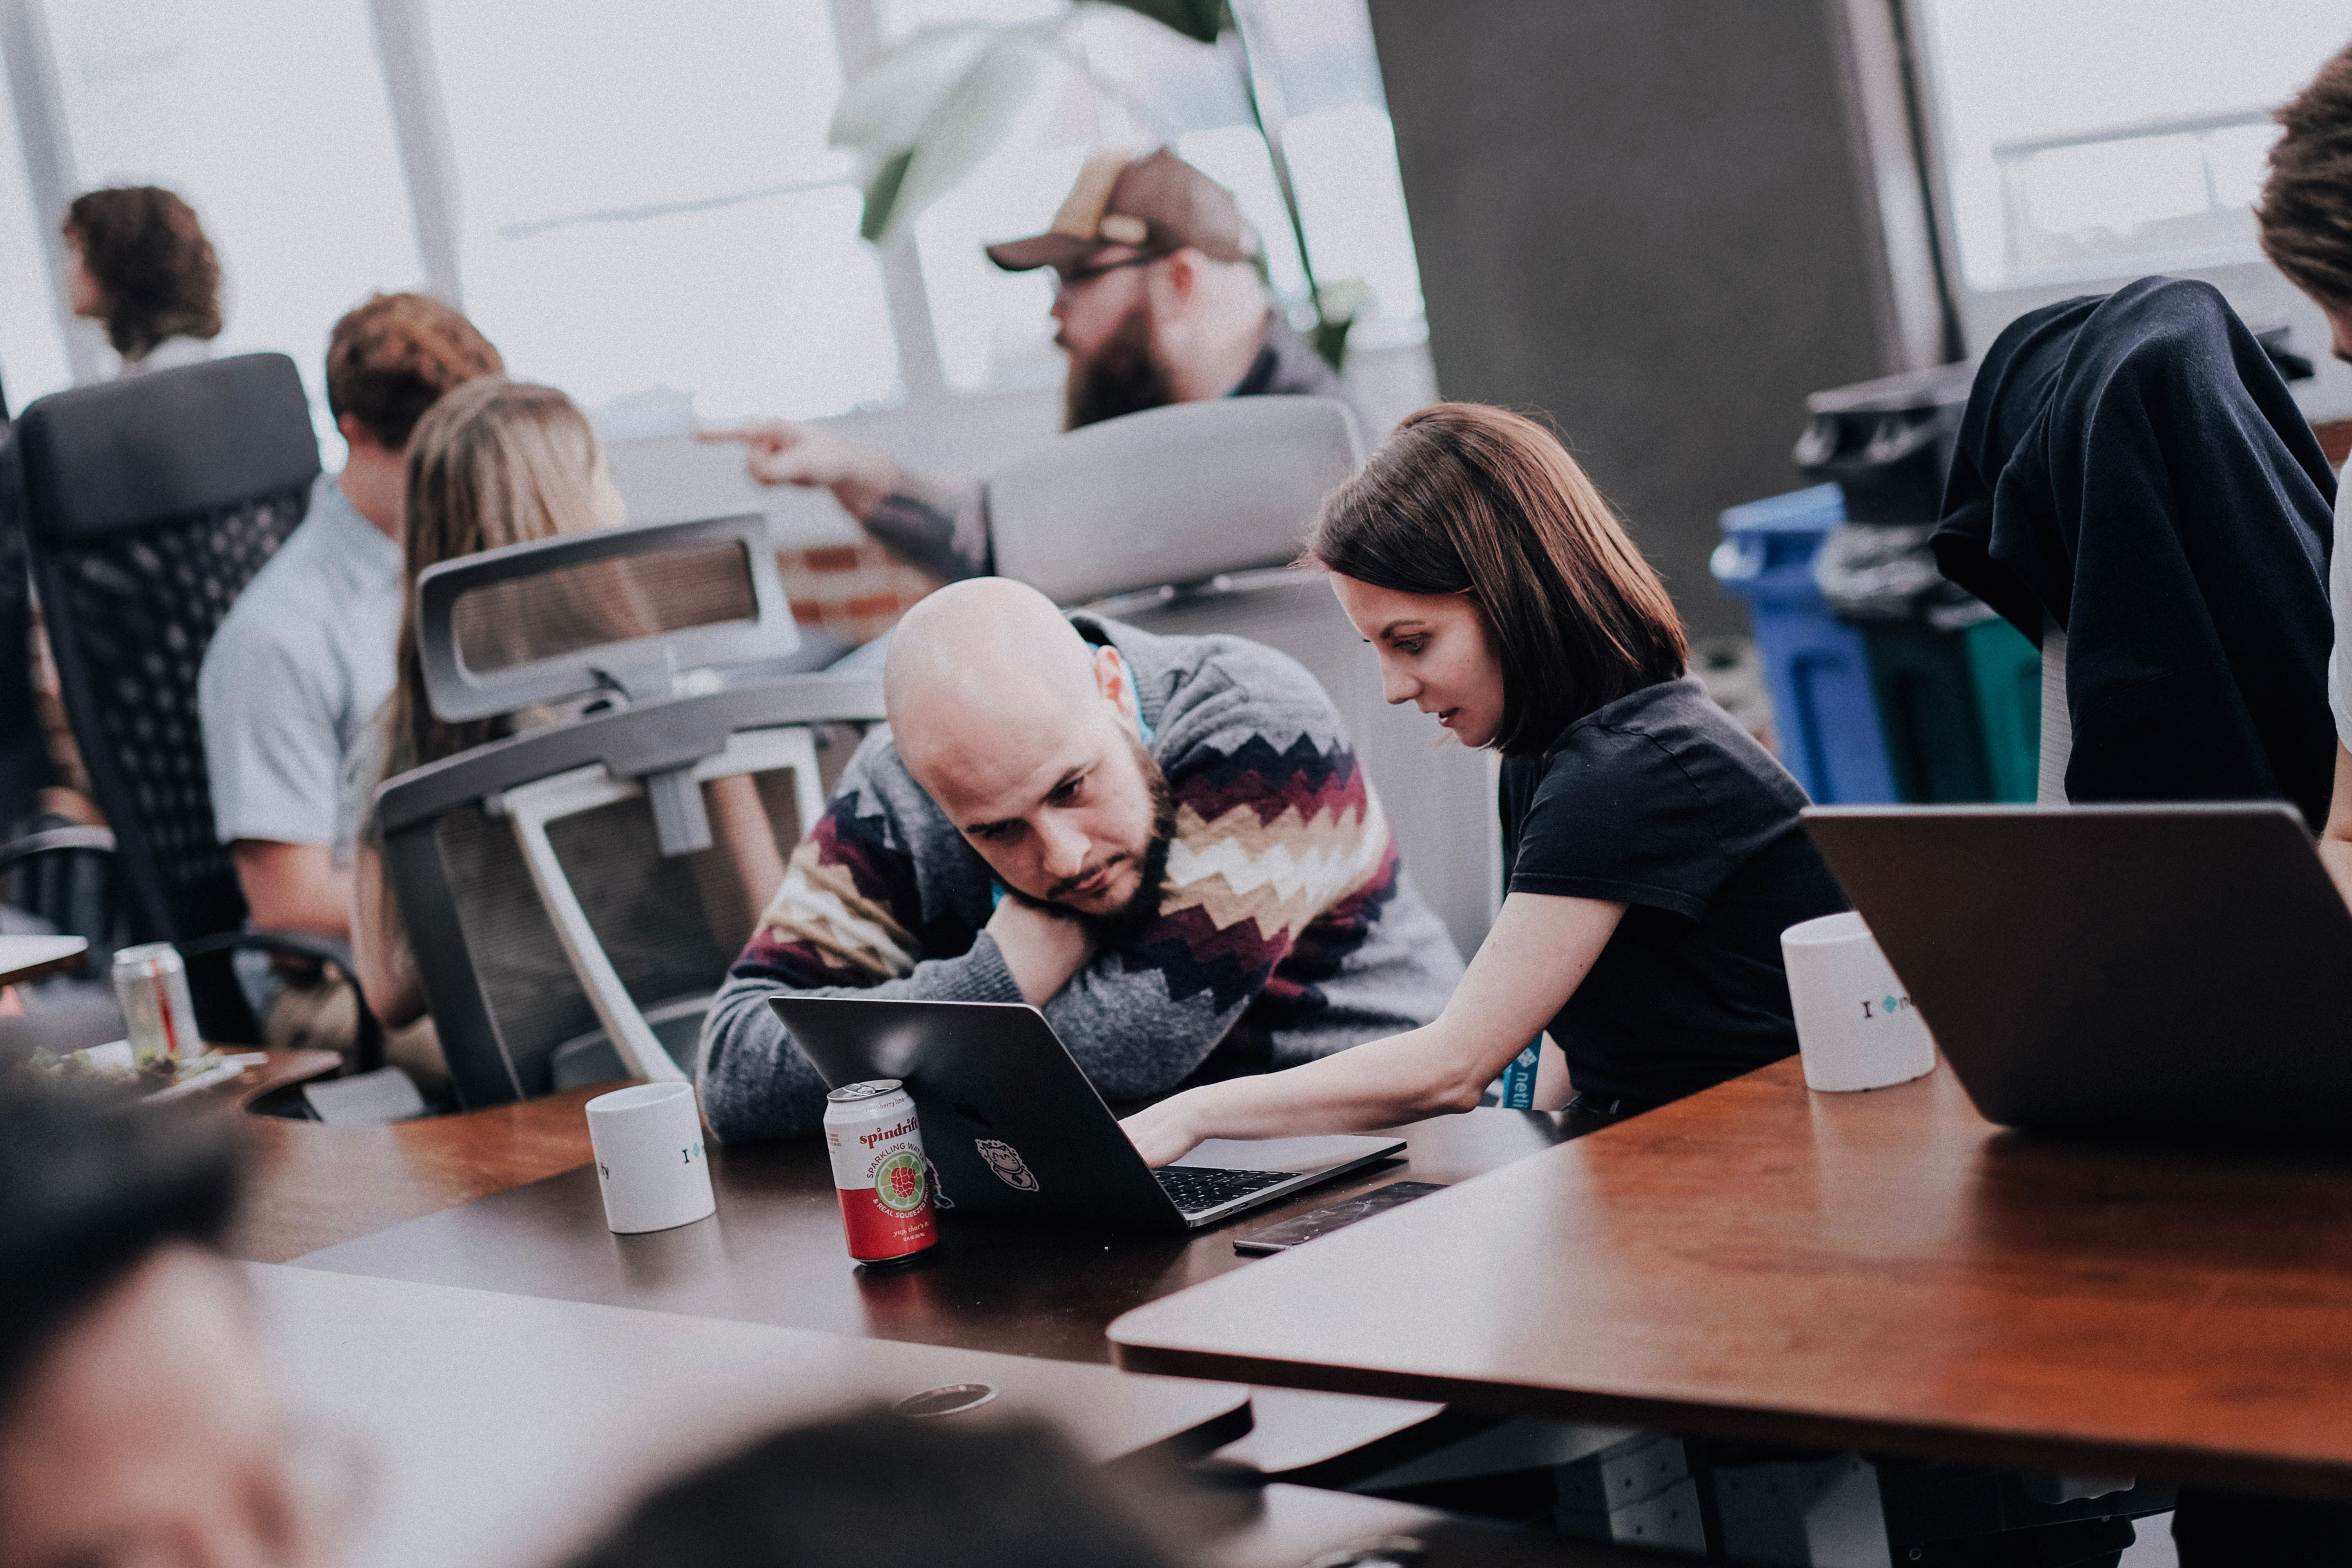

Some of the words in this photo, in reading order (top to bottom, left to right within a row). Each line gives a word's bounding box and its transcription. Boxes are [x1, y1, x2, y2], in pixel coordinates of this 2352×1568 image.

[865, 1102, 895, 1112] raspberry
[859, 1117, 918, 1149] spindrift
[867, 1142, 906, 1179] SPARKLING
[877, 1203, 893, 1217] REAL
[895, 1202, 926, 1218] SQUEEZED
[908, 1223, 924, 1232] that's
